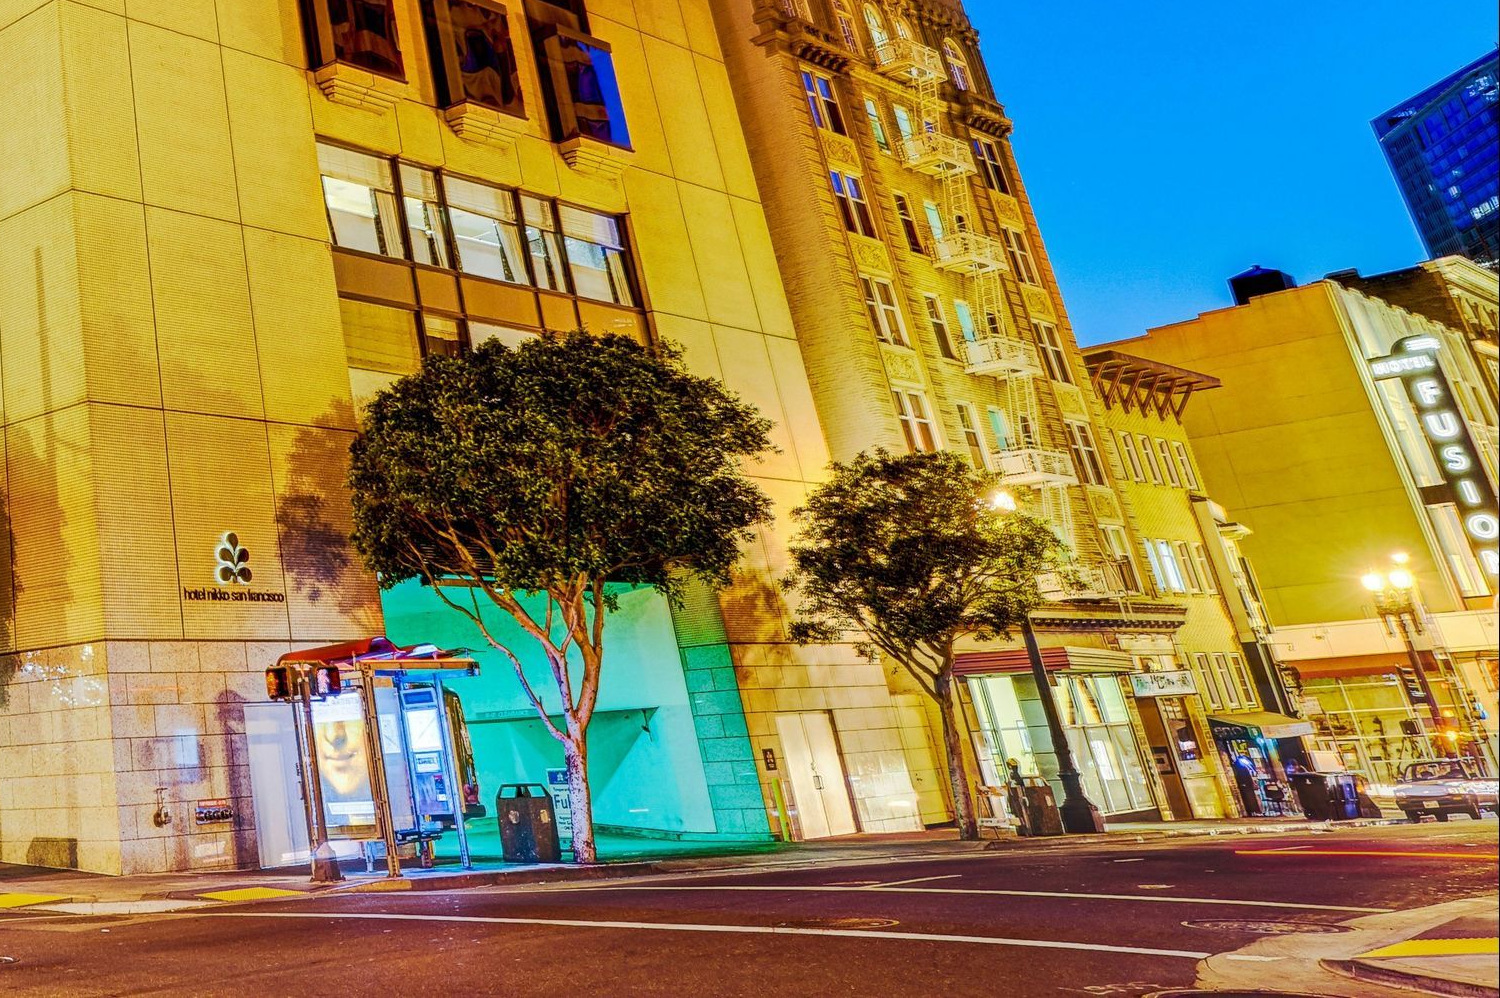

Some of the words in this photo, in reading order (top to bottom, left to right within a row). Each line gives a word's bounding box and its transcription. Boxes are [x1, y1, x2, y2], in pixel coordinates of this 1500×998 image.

[1371, 355, 1436, 375] HOTEL
[1416, 380, 1499, 575] FUSION
[183, 587, 205, 601] hotel
[207, 588, 230, 601] nikko
[232, 591, 247, 602] san
[248, 589, 284, 602] francisco
[554, 794, 572, 809] Ful
